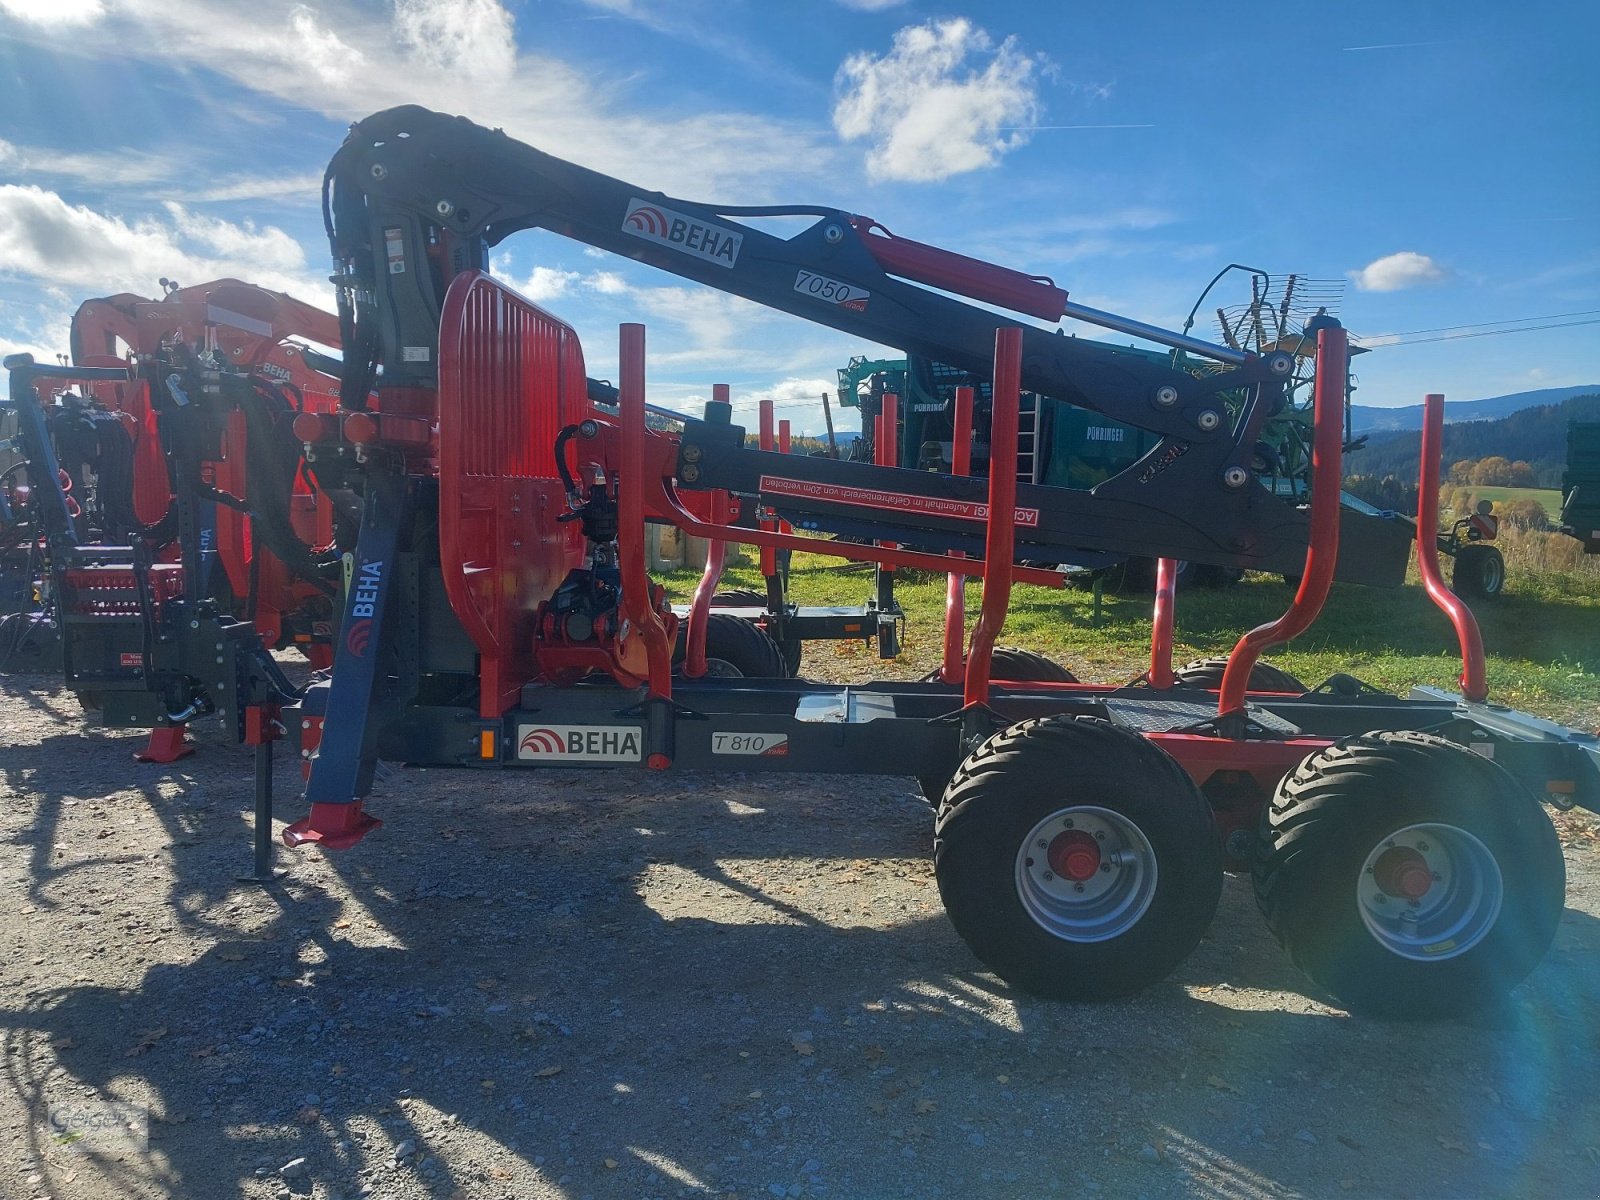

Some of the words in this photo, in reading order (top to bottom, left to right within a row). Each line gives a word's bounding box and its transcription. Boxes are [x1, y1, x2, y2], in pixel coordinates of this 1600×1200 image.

[668, 218, 734, 262] BEHA
[796, 271, 850, 302] 7050
[263, 362, 291, 381] BEHA
[765, 479, 801, 490] verboten
[803, 485, 821, 495] 20m
[823, 487, 838, 495] von
[841, 490, 911, 506] Gefahrenbereich
[912, 499, 924, 507] im
[924, 500, 969, 513] Aufenthalt
[352, 561, 383, 617] BEHA
[567, 731, 639, 755] BEHA
[714, 735, 728, 750] T
[731, 735, 765, 751] 810
